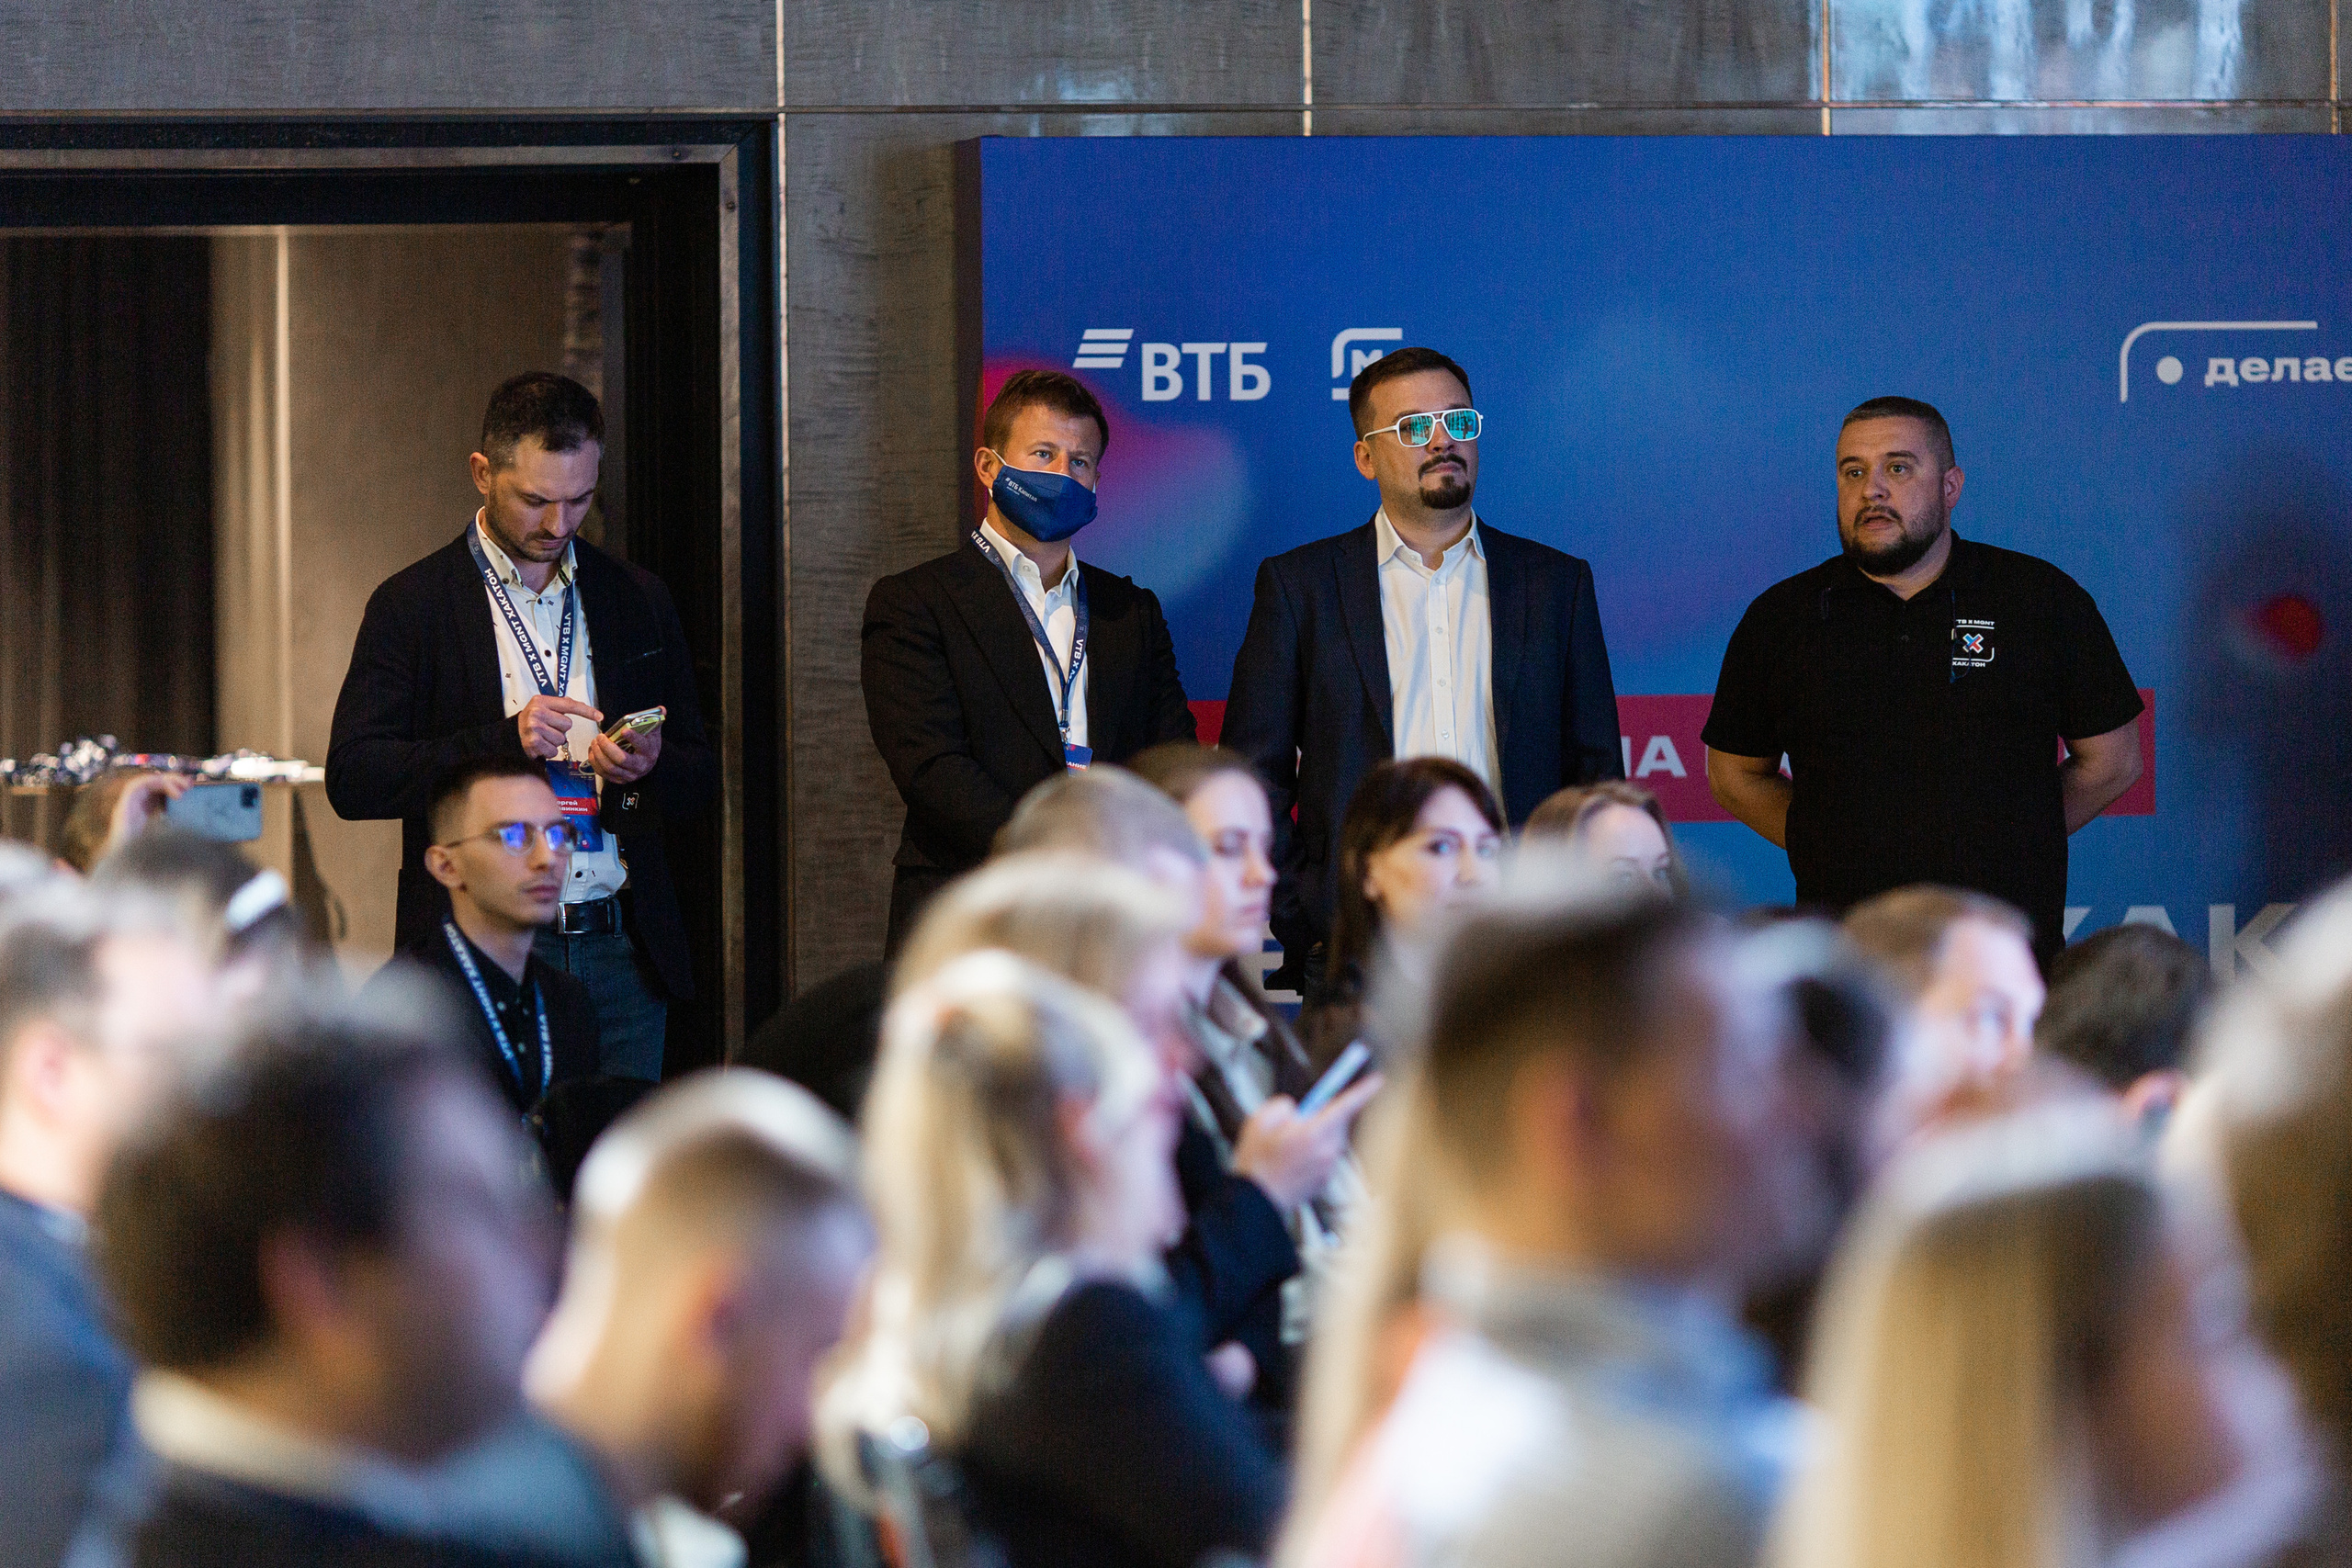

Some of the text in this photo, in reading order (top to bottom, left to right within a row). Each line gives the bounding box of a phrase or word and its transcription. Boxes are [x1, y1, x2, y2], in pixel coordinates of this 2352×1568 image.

[1142, 342, 1272, 401] ВТБ
[975, 536, 990, 553] VTB
[484, 567, 516, 619] ХАКАТОН
[511, 620, 533, 653] MGNT
[562, 613, 571, 635] VTB
[1074, 638, 1084, 660] VTB
[533, 661, 548, 687] VTB
[560, 646, 570, 681] MGNT
[1066, 761, 1087, 770] АНИЕ
